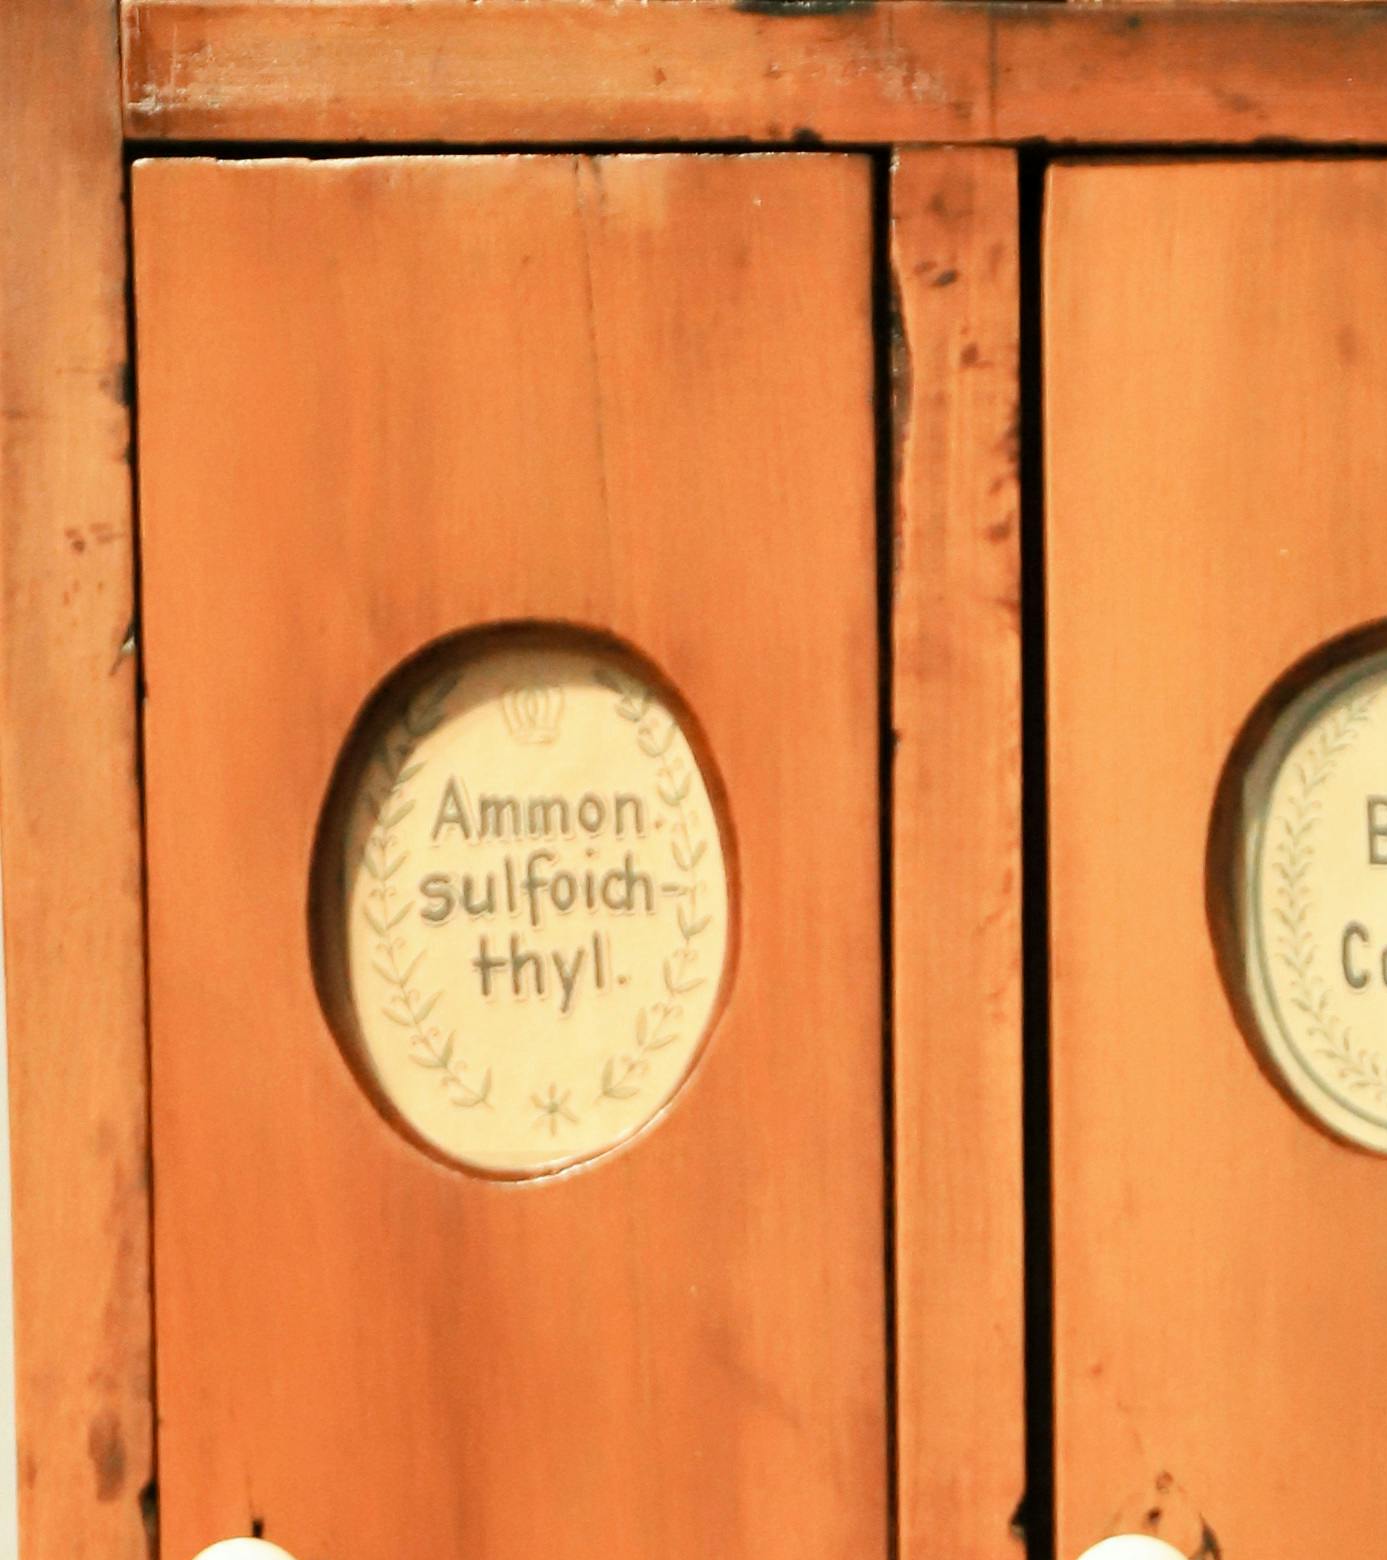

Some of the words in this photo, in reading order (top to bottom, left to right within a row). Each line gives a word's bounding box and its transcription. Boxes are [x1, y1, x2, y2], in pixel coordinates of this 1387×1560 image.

[430, 774, 664, 839] Ammon.
[418, 847, 680, 925] sulfoich-
[473, 933, 630, 1012] thyl.
